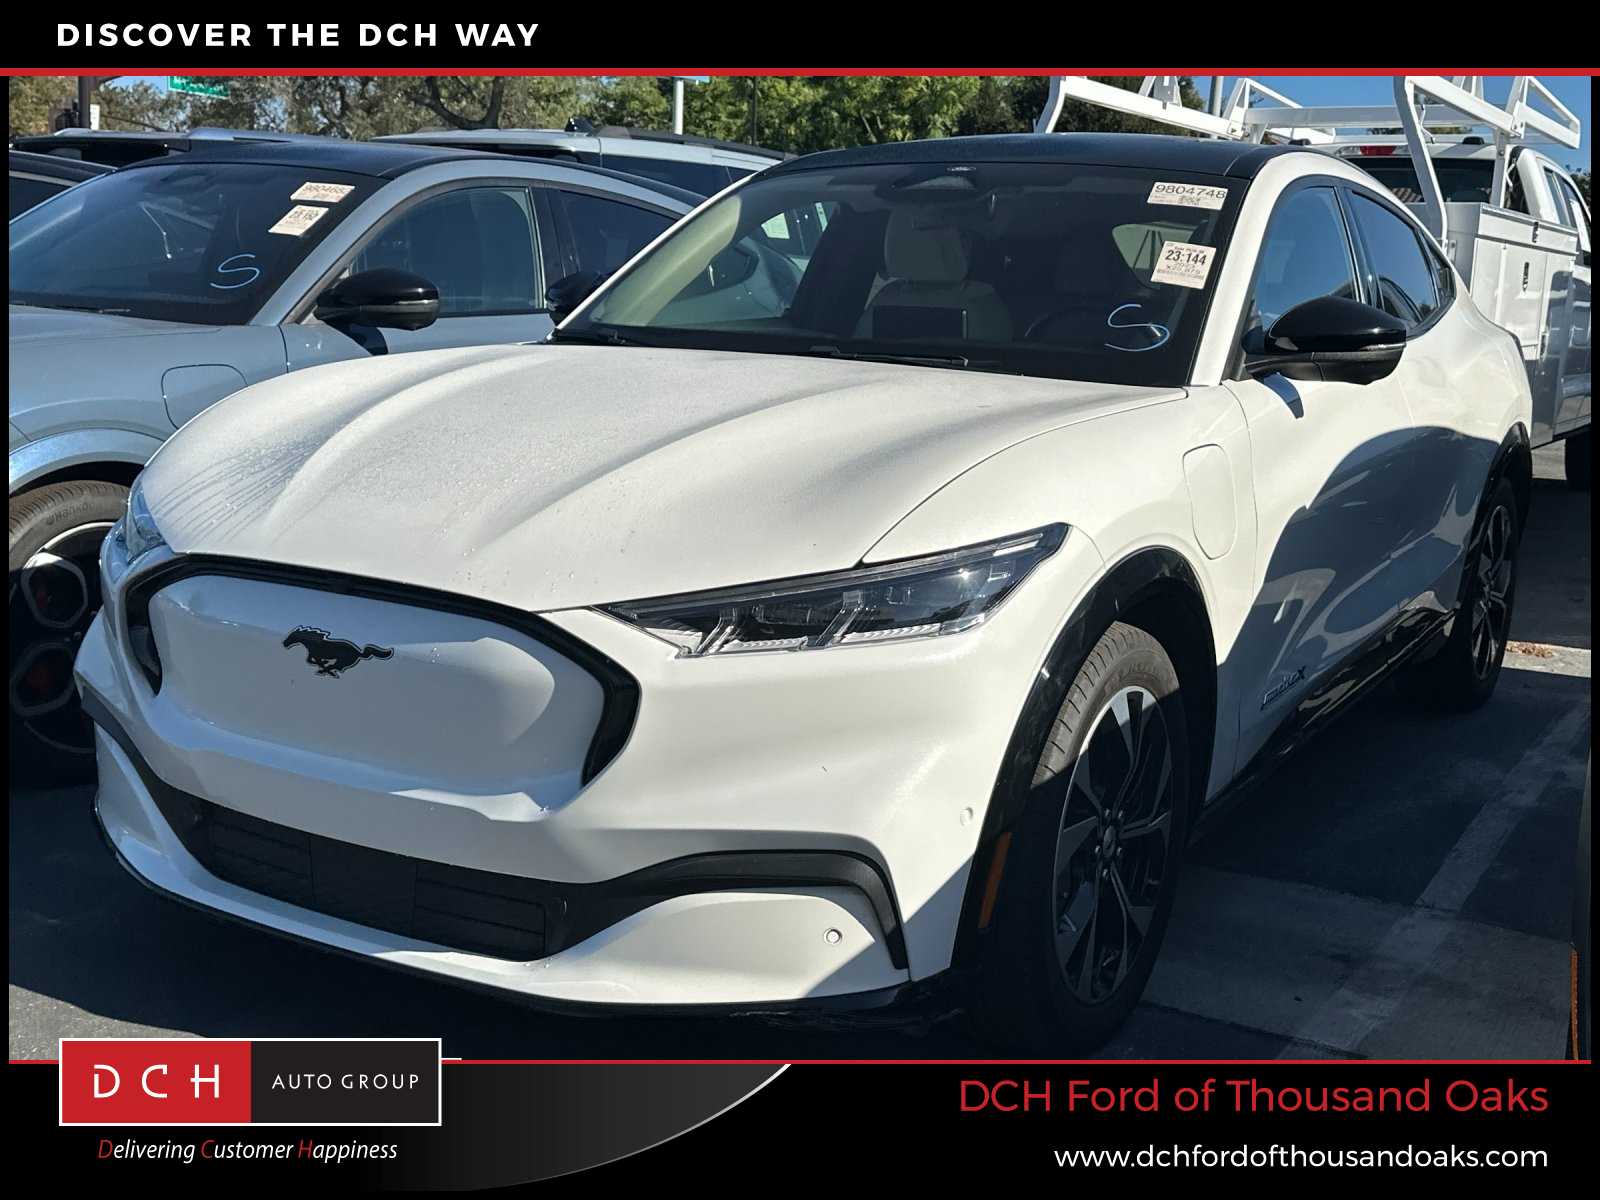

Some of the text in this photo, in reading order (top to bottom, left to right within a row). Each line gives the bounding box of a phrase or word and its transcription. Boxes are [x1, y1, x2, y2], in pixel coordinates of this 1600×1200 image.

[1154, 184, 1227, 199] 9804748
[210, 253, 260, 289] S
[1164, 250, 1207, 266] 23:144
[1103, 303, 1170, 352] S
